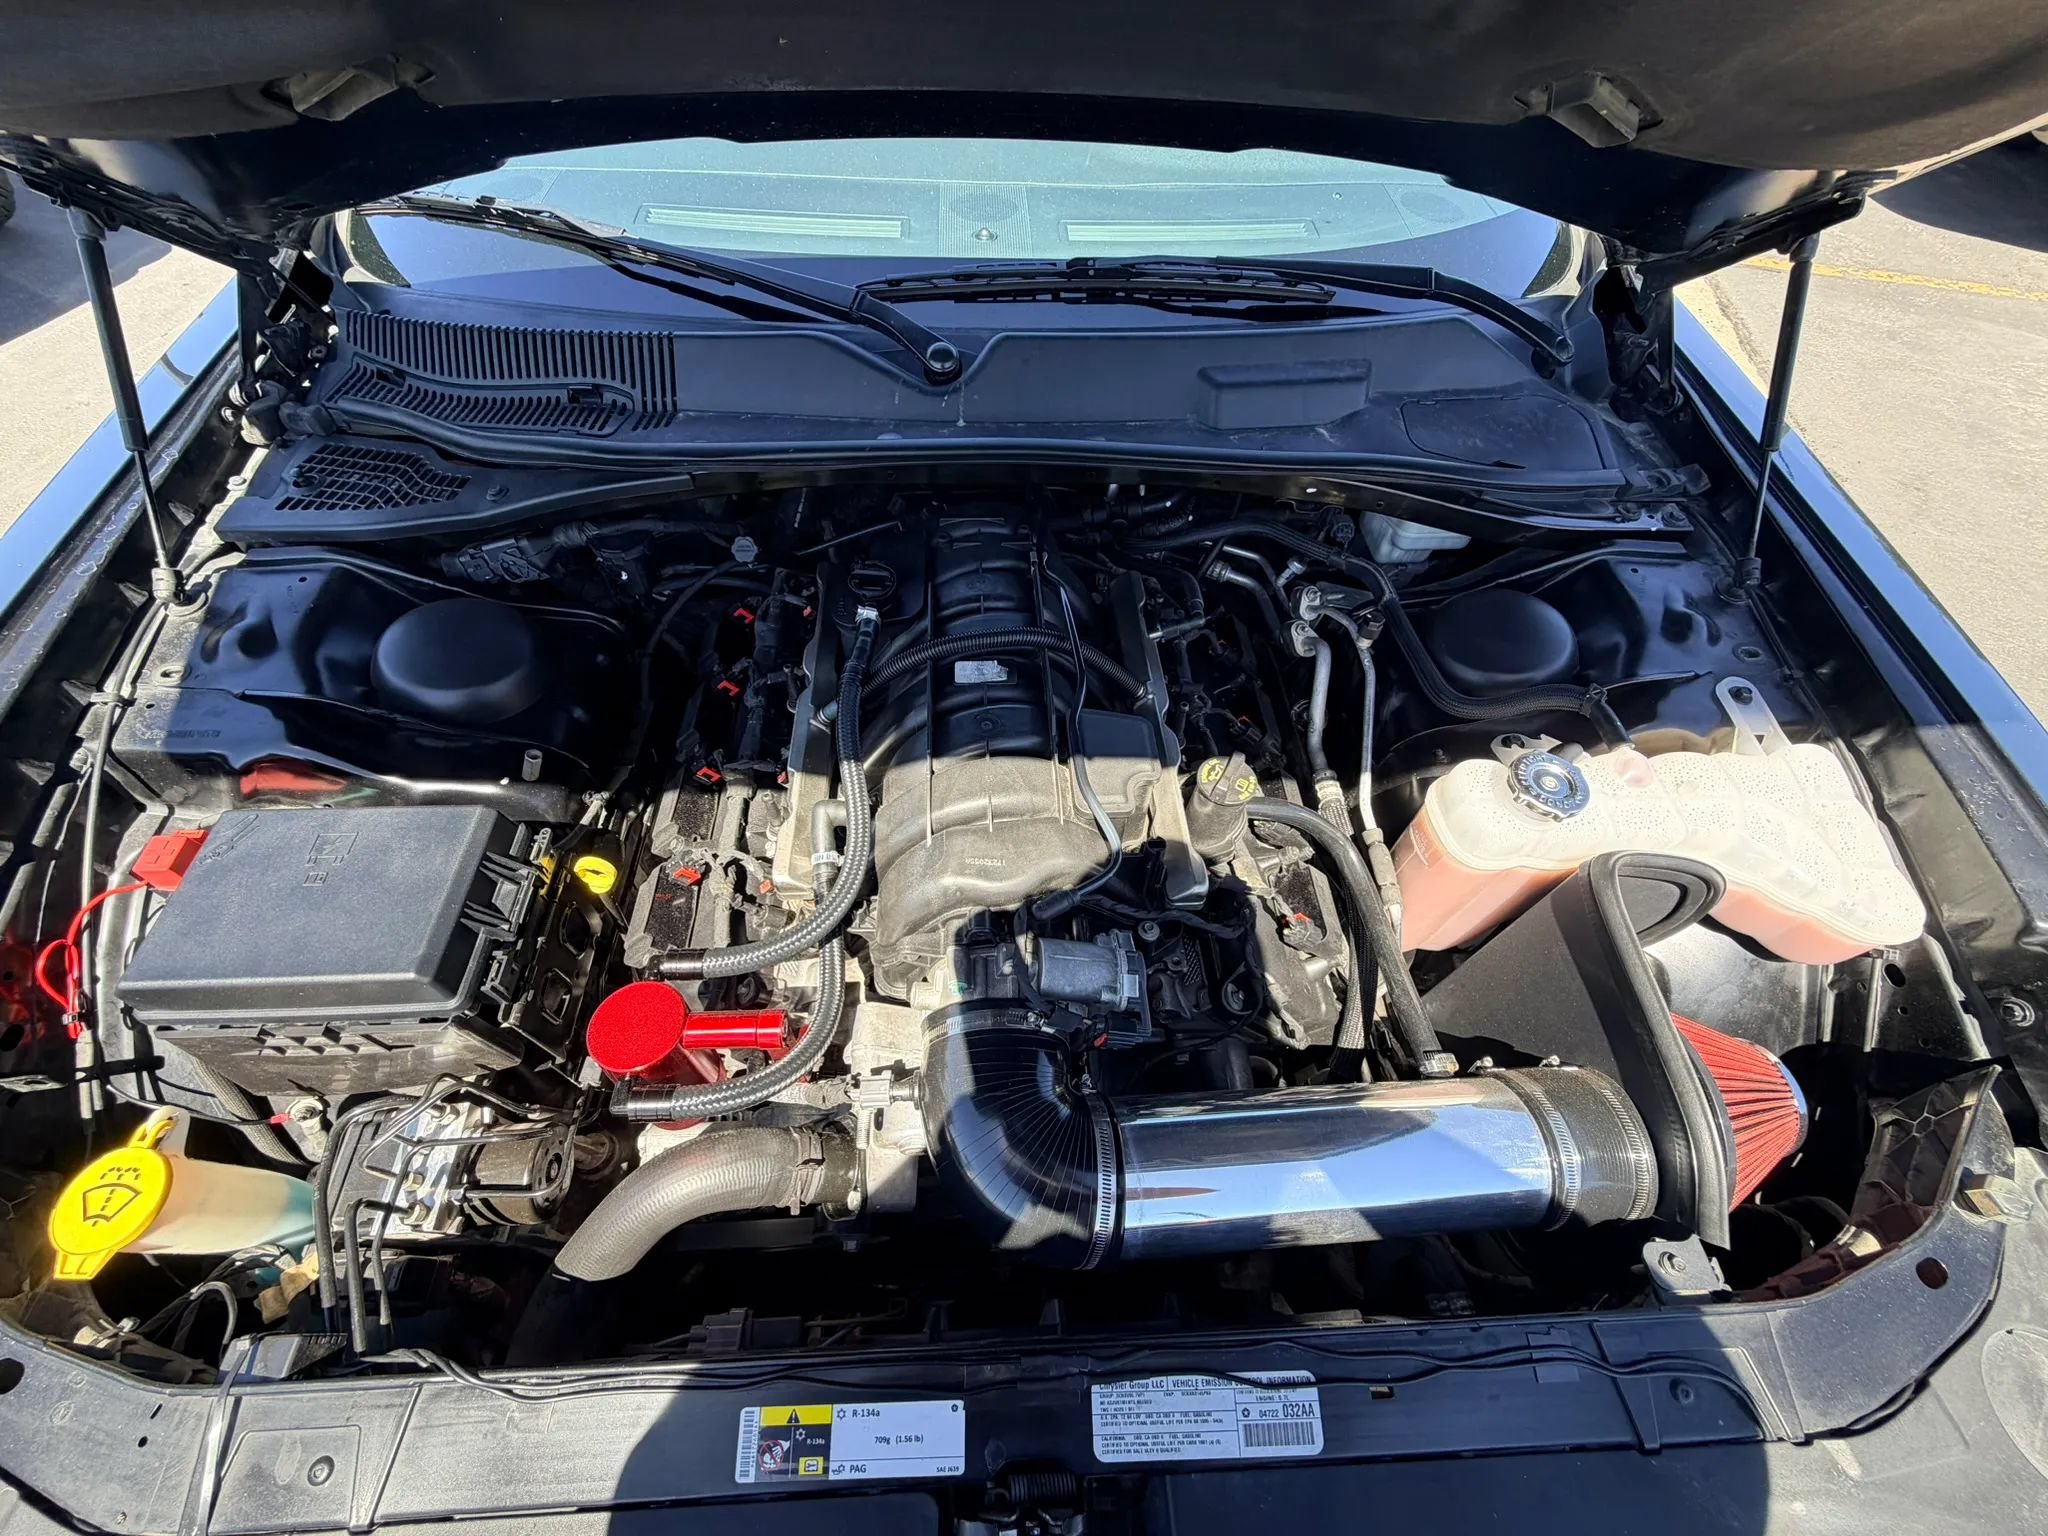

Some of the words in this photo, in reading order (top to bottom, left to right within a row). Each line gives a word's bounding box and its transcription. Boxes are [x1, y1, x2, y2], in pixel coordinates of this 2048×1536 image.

[1129, 1381, 1150, 1390] Group
[1151, 1380, 1165, 1389] LLC
[1172, 1379, 1200, 1388] VEHICLE
[851, 1408, 881, 1418] R-134a
[1259, 1409, 1280, 1418] 04722
[1282, 1403, 1315, 1418] 032AA
[807, 1437, 826, 1445] R-134a
[874, 1435, 891, 1445] 709g
[895, 1434, 913, 1445] (1.56
[914, 1433, 924, 1444] lb)
[849, 1463, 867, 1474] PAG
